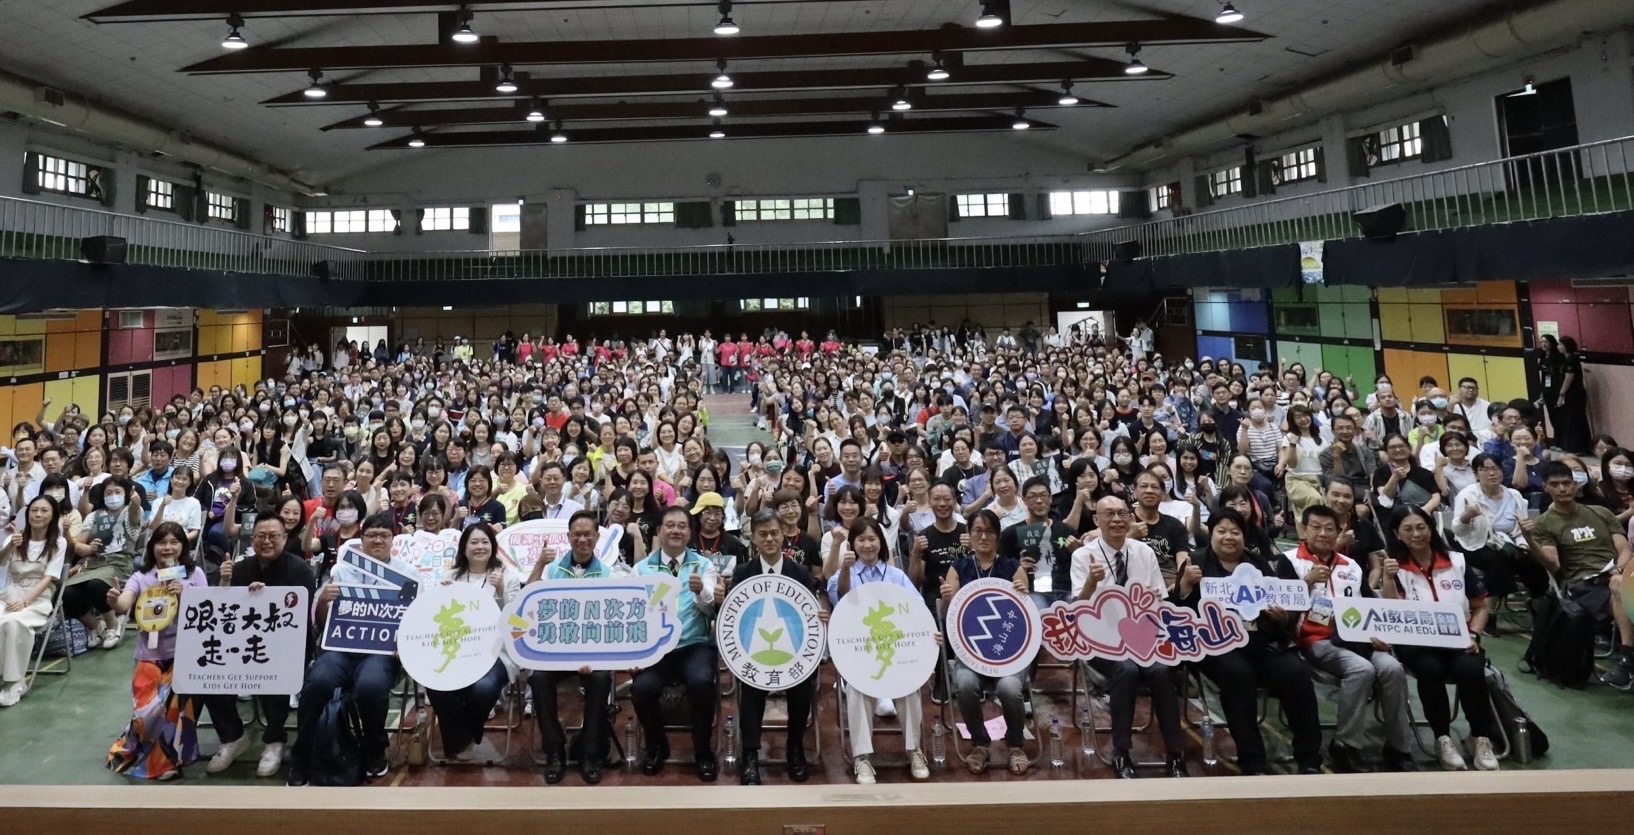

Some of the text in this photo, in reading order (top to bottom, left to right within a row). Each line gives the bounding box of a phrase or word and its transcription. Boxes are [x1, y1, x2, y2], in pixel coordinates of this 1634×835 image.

[980, 579, 999, 588] HIGH
[1204, 582, 1233, 595] 新北
[338, 600, 408, 619] 夢的N次方
[537, 598, 647, 621] 夢的N次方
[1266, 594, 1305, 606] 教育局
[184, 600, 298, 634] 跟著大叔
[723, 581, 820, 662] MINISTRY OF EDUCATION
[537, 621, 648, 644] 勇敢向前飛
[992, 610, 1018, 655] 海山高中
[1043, 610, 1087, 652] 我
[1375, 624, 1437, 635] NTPC AI EDU
[197, 635, 270, 667] 走一走
[741, 662, 804, 685] 教育部
